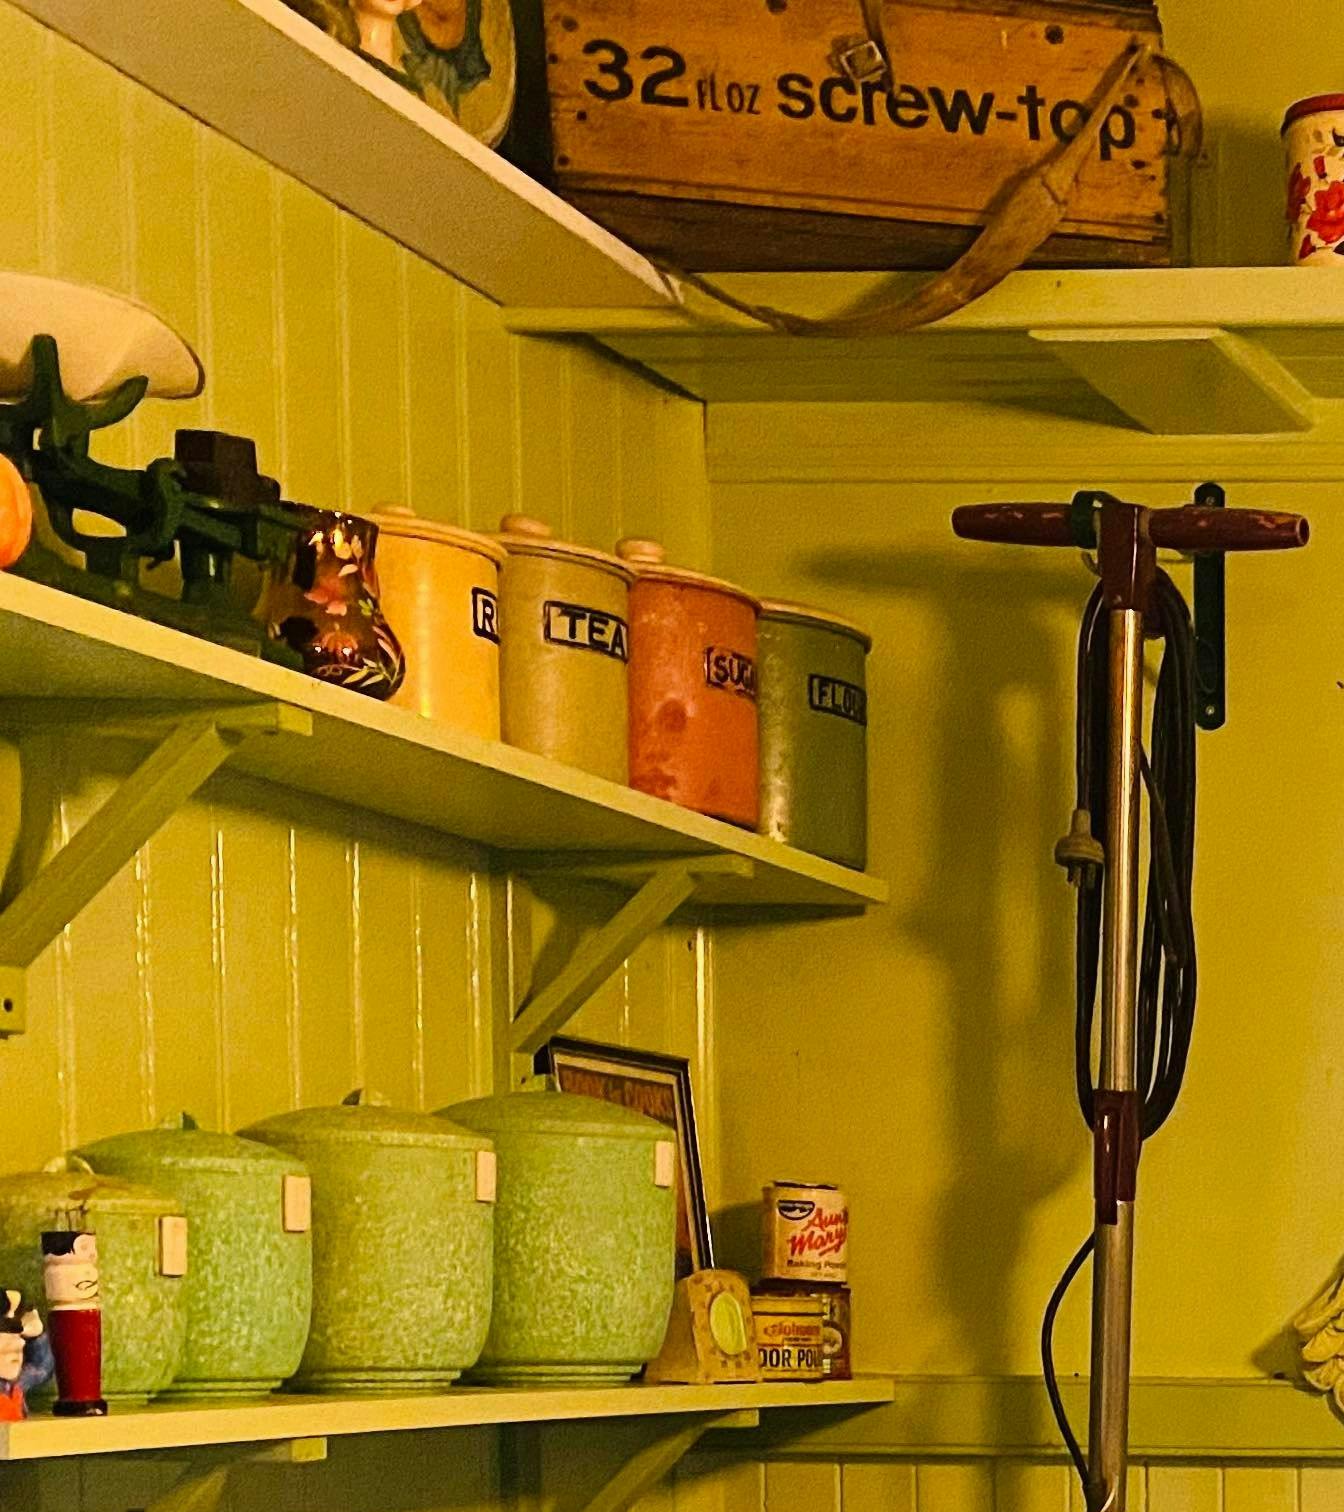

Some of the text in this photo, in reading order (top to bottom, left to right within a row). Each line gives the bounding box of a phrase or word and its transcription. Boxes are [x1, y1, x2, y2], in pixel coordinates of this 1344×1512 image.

[582, 39, 690, 108] 32
[776, 71, 1136, 161] screw-top
[557, 608, 628, 654] TEA
